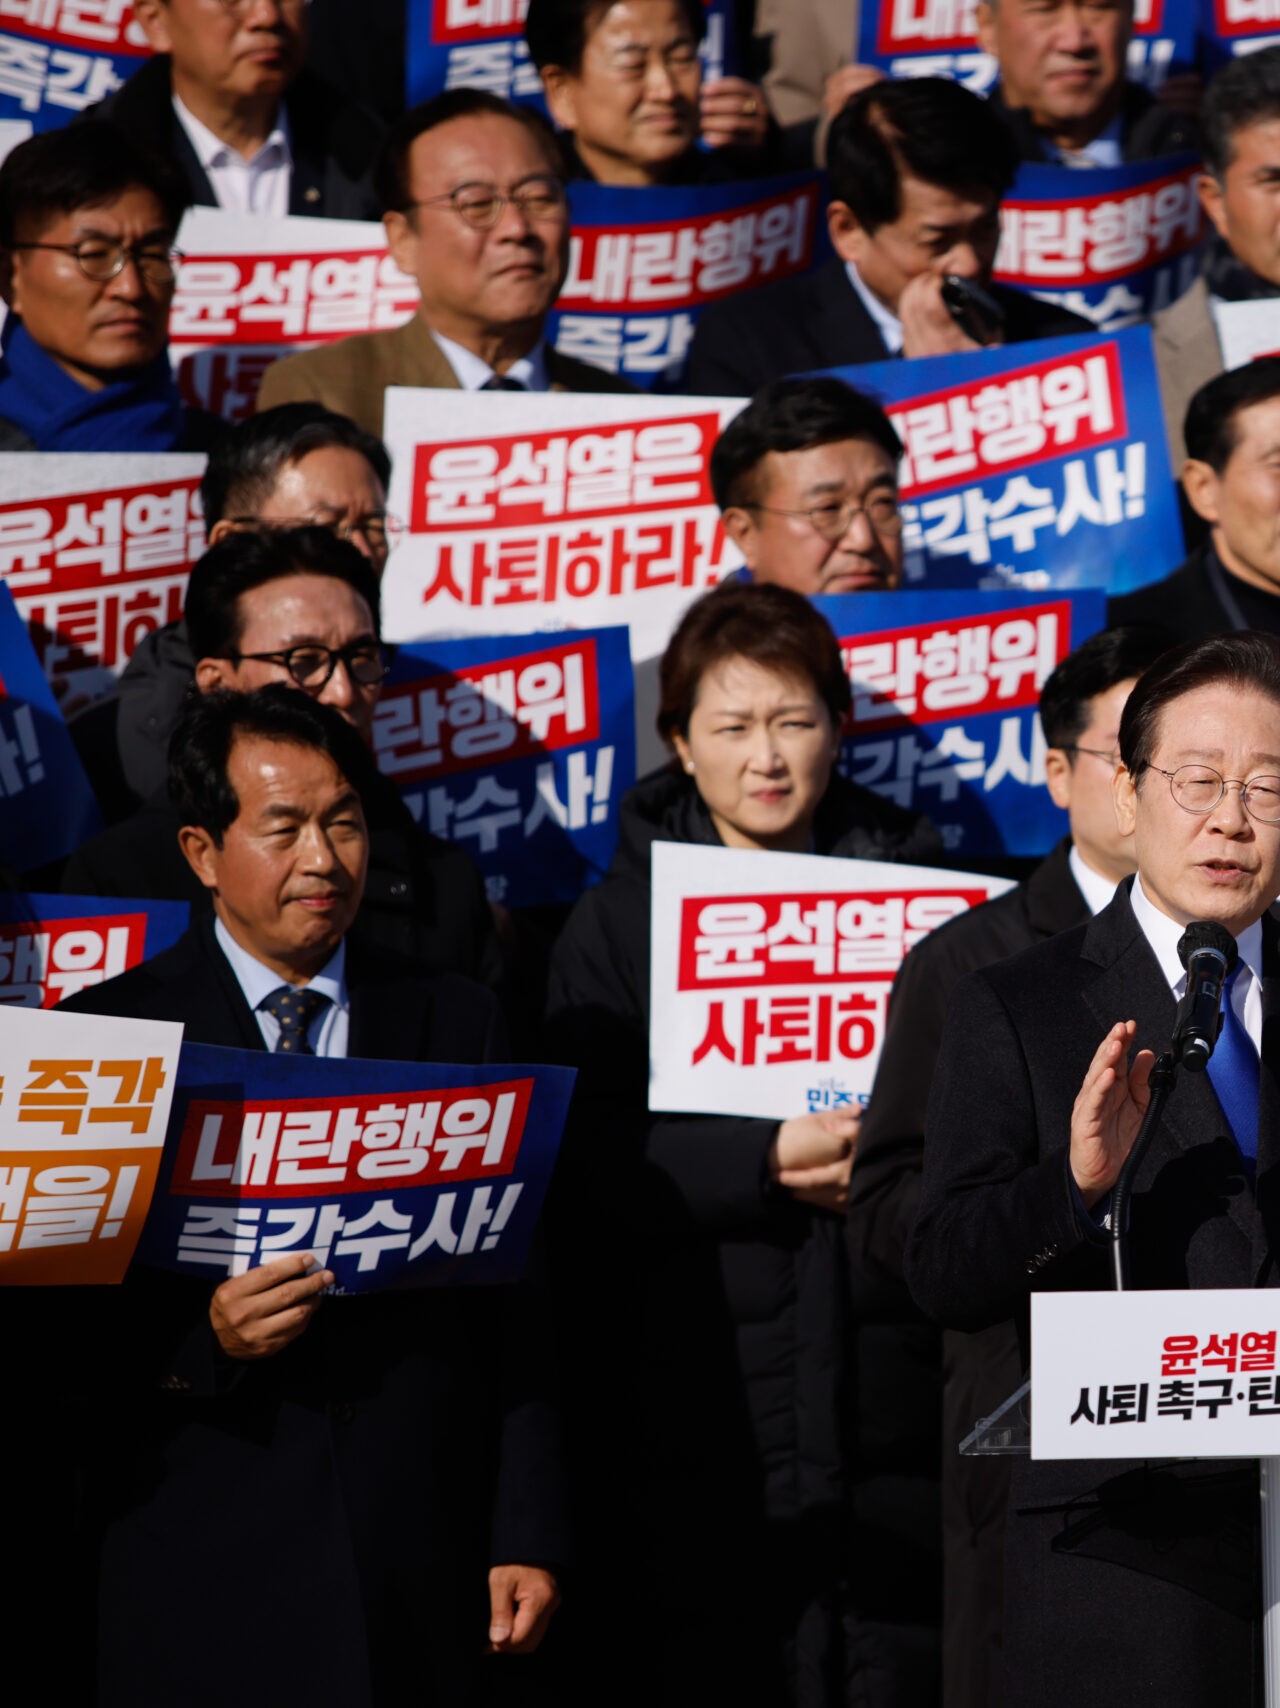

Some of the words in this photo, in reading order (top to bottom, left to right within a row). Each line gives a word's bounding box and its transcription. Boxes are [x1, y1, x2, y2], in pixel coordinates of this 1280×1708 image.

[558, 194, 811, 304] 내란행위
[890, 354, 1115, 490] 란행위
[425, 421, 705, 526] 윤석열은
[0, 485, 207, 584] 윤석열
[423, 519, 726, 607] 사퇴하라!
[841, 612, 1060, 723] 란행위
[18, 1056, 166, 1136] 즉각
[190, 1090, 518, 1187] 내란행위
[176, 1181, 525, 1280] 즉각수사!
[1161, 1330, 1277, 1377] 윤석열
[1070, 1383, 1150, 1426] 사퇴
